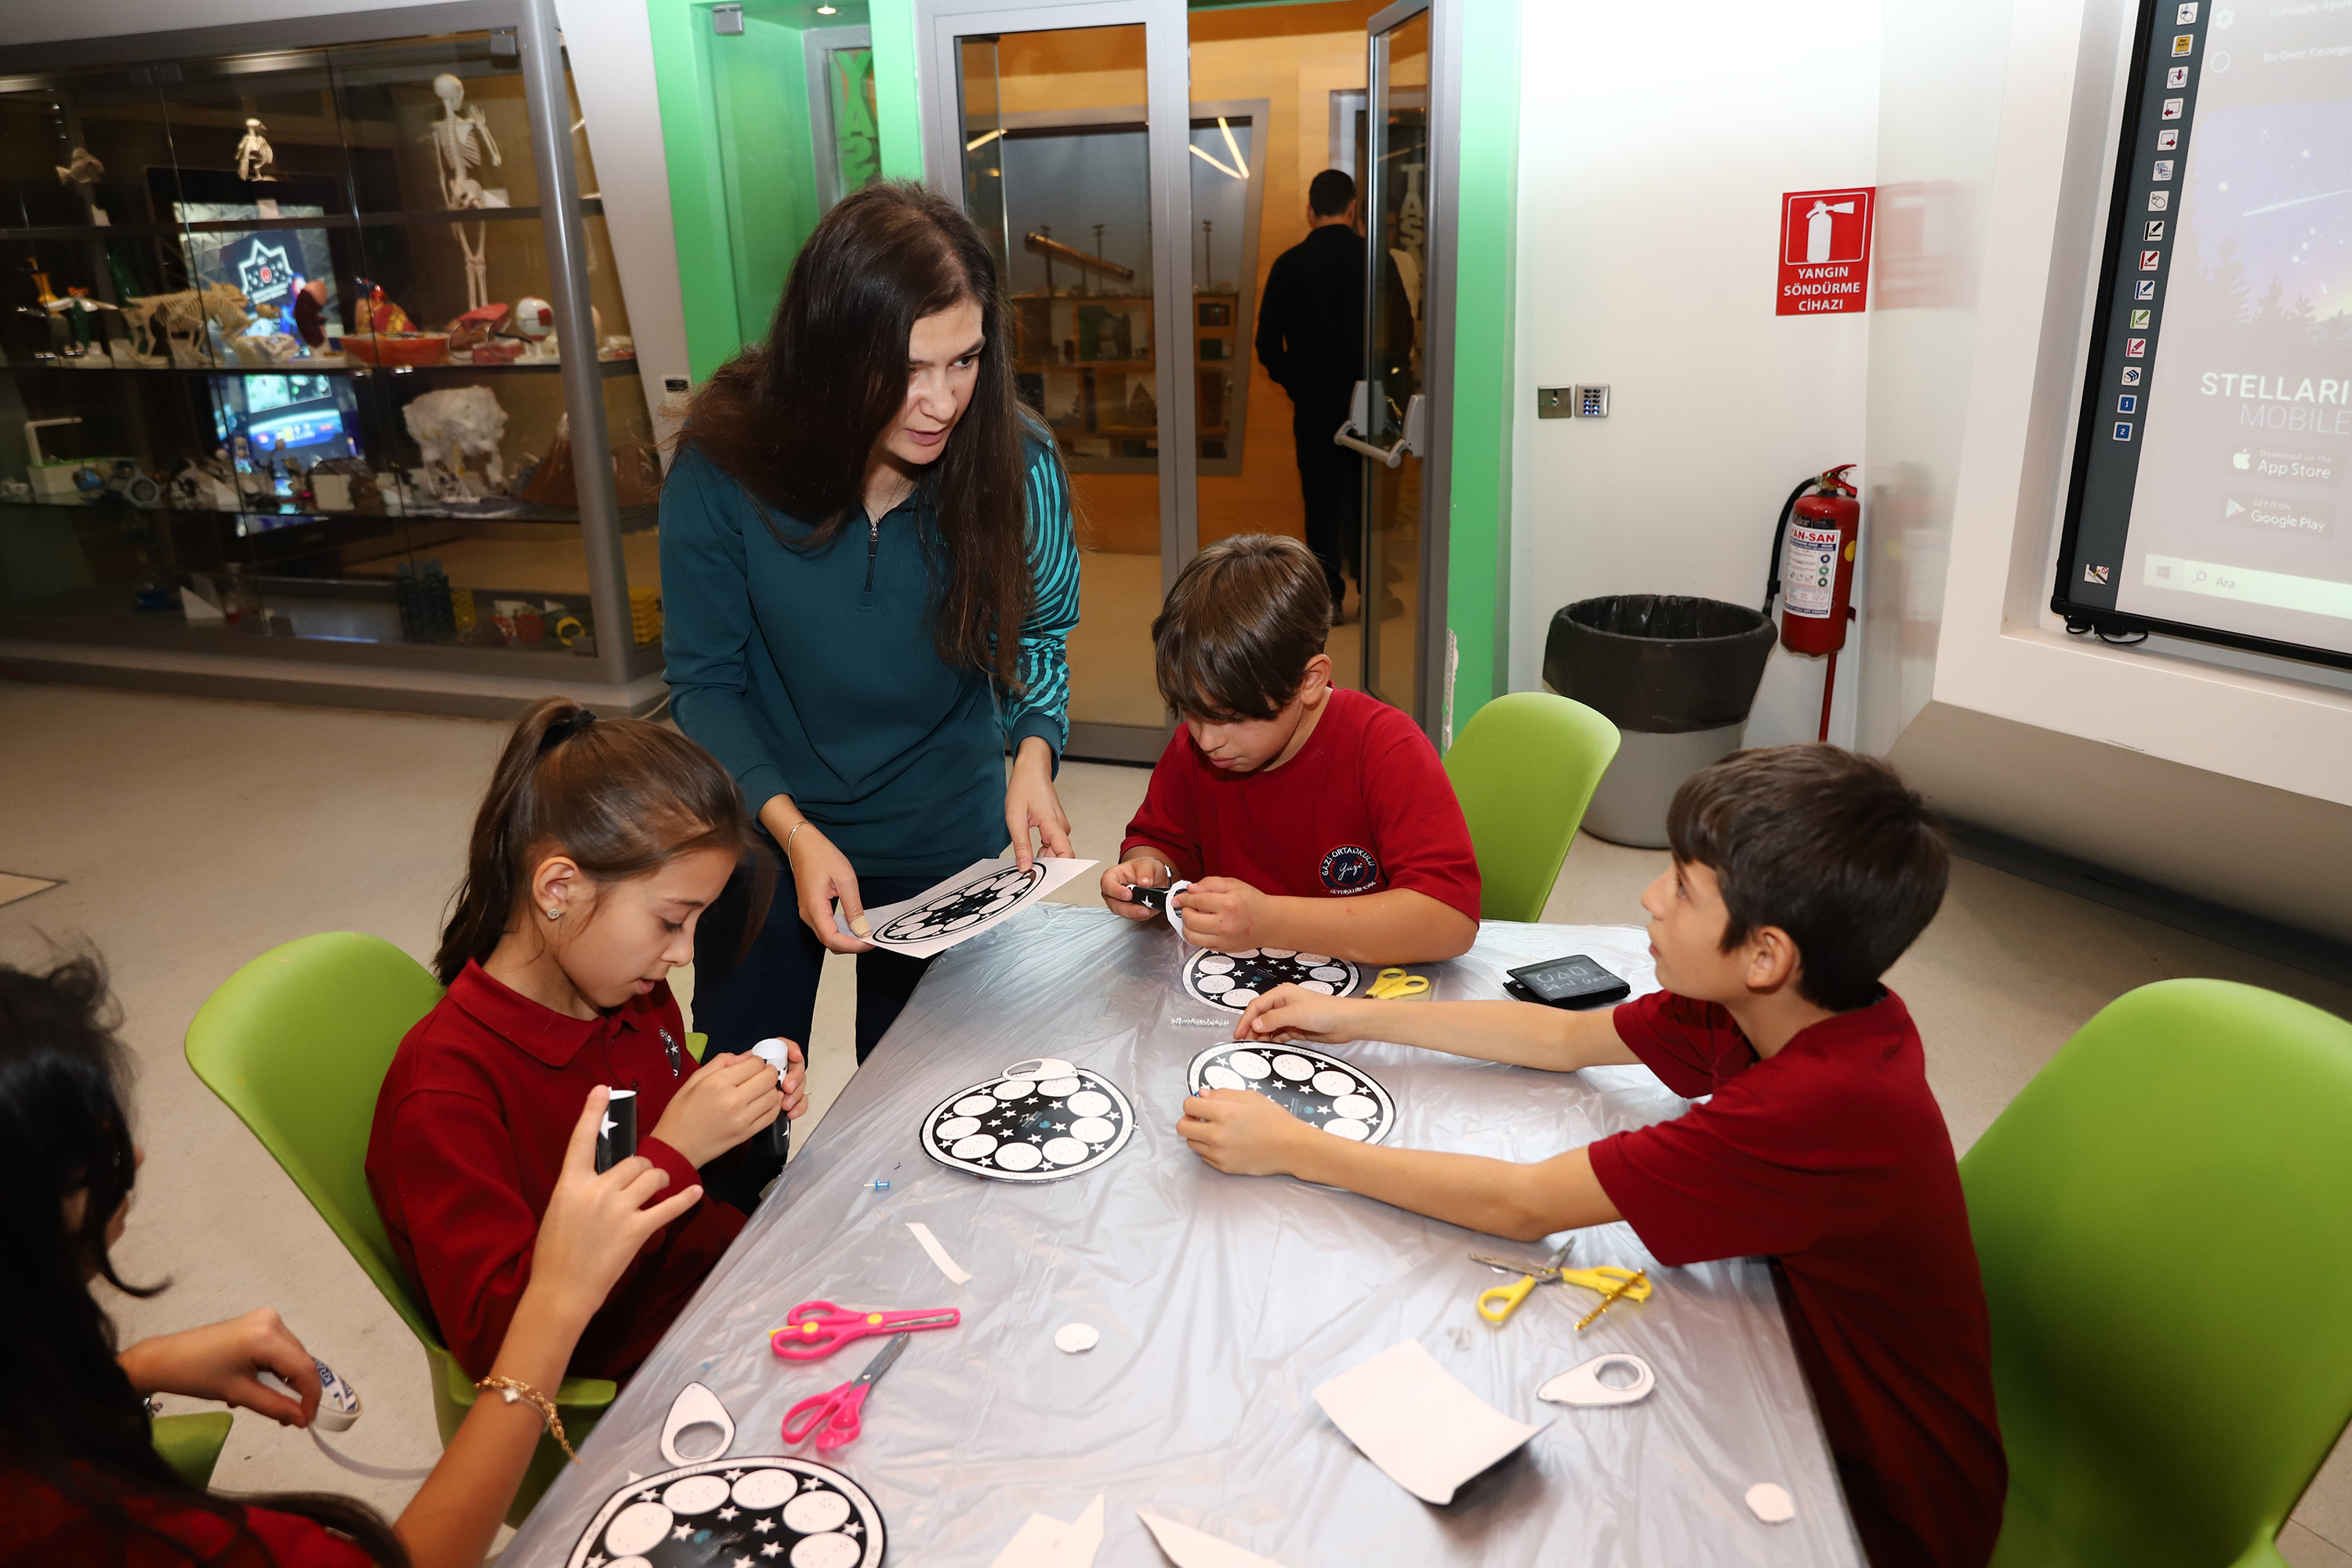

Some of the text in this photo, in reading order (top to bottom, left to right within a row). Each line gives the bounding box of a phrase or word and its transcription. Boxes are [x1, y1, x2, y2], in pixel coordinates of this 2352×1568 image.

[2263, 52, 2278, 64] Bu
[1798, 267, 1849, 280] YANGIN
[1784, 281, 1860, 297] SÖNDÜRME
[1798, 299, 1844, 312] CİHAZI
[2200, 372, 2350, 405] STELLARI
[2240, 404, 2352, 435] MOBILE
[2259, 449, 2302, 461] Download
[2257, 459, 2332, 480] App Store
[2251, 510, 2326, 533] Google Play
[2214, 575, 2236, 590] Ara
